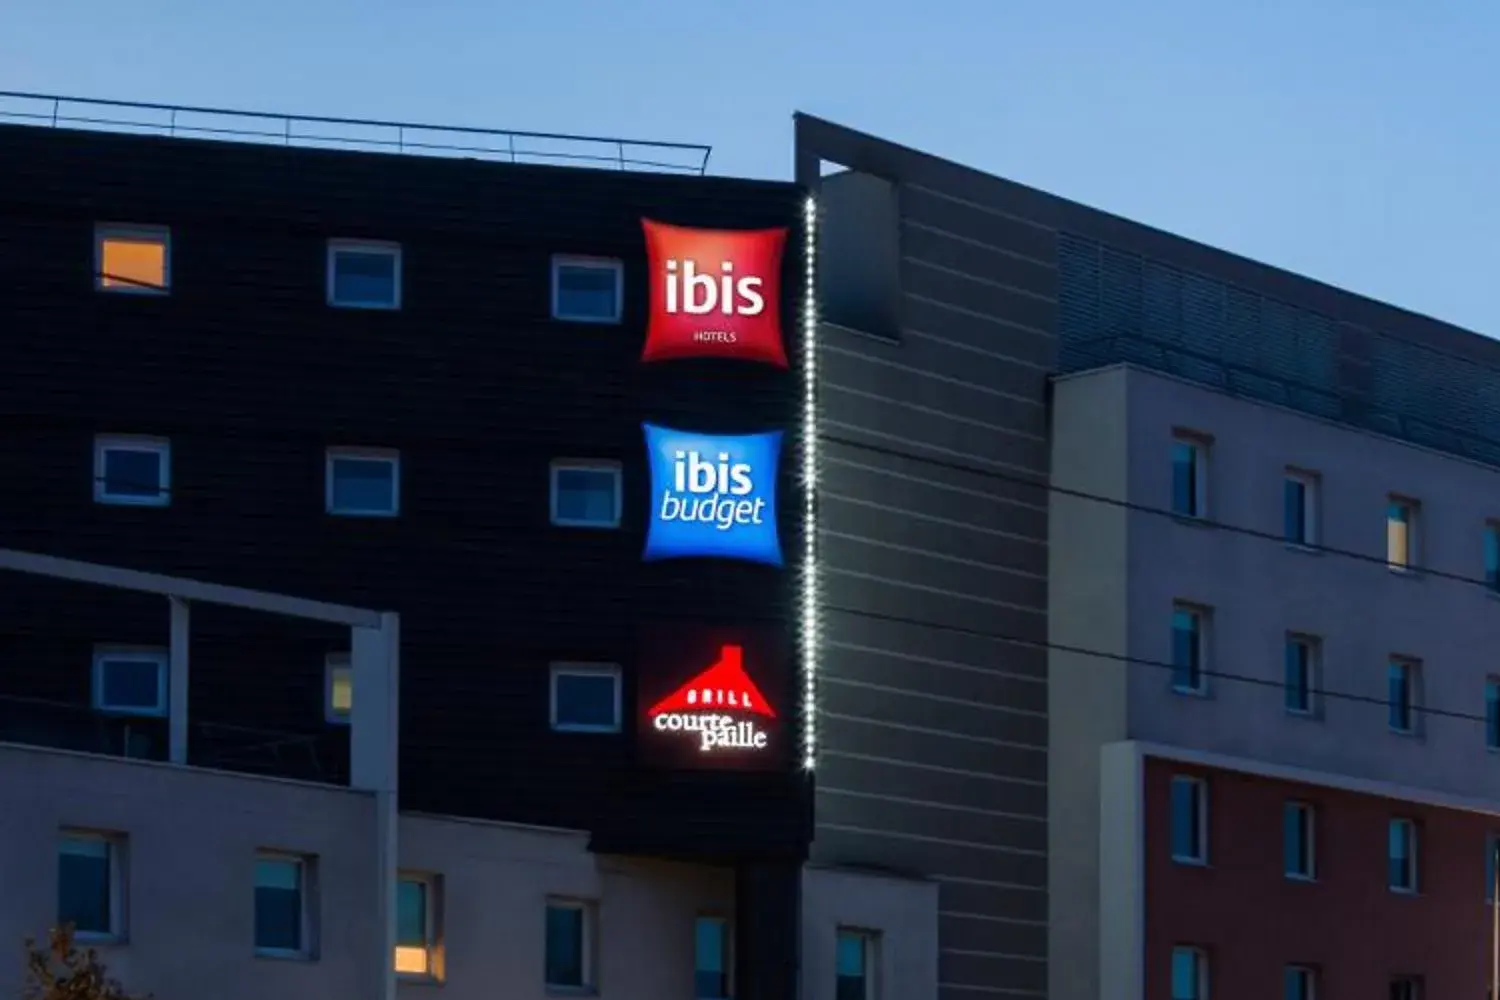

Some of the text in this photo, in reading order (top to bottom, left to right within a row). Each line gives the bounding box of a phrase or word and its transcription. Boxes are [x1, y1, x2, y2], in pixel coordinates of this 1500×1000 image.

[666, 259, 764, 315] ibis
[693, 331, 737, 342] HOTELS
[675, 450, 752, 495] ibis
[661, 489, 765, 530] budget
[655, 713, 733, 731] courte
[700, 721, 767, 751] paille
